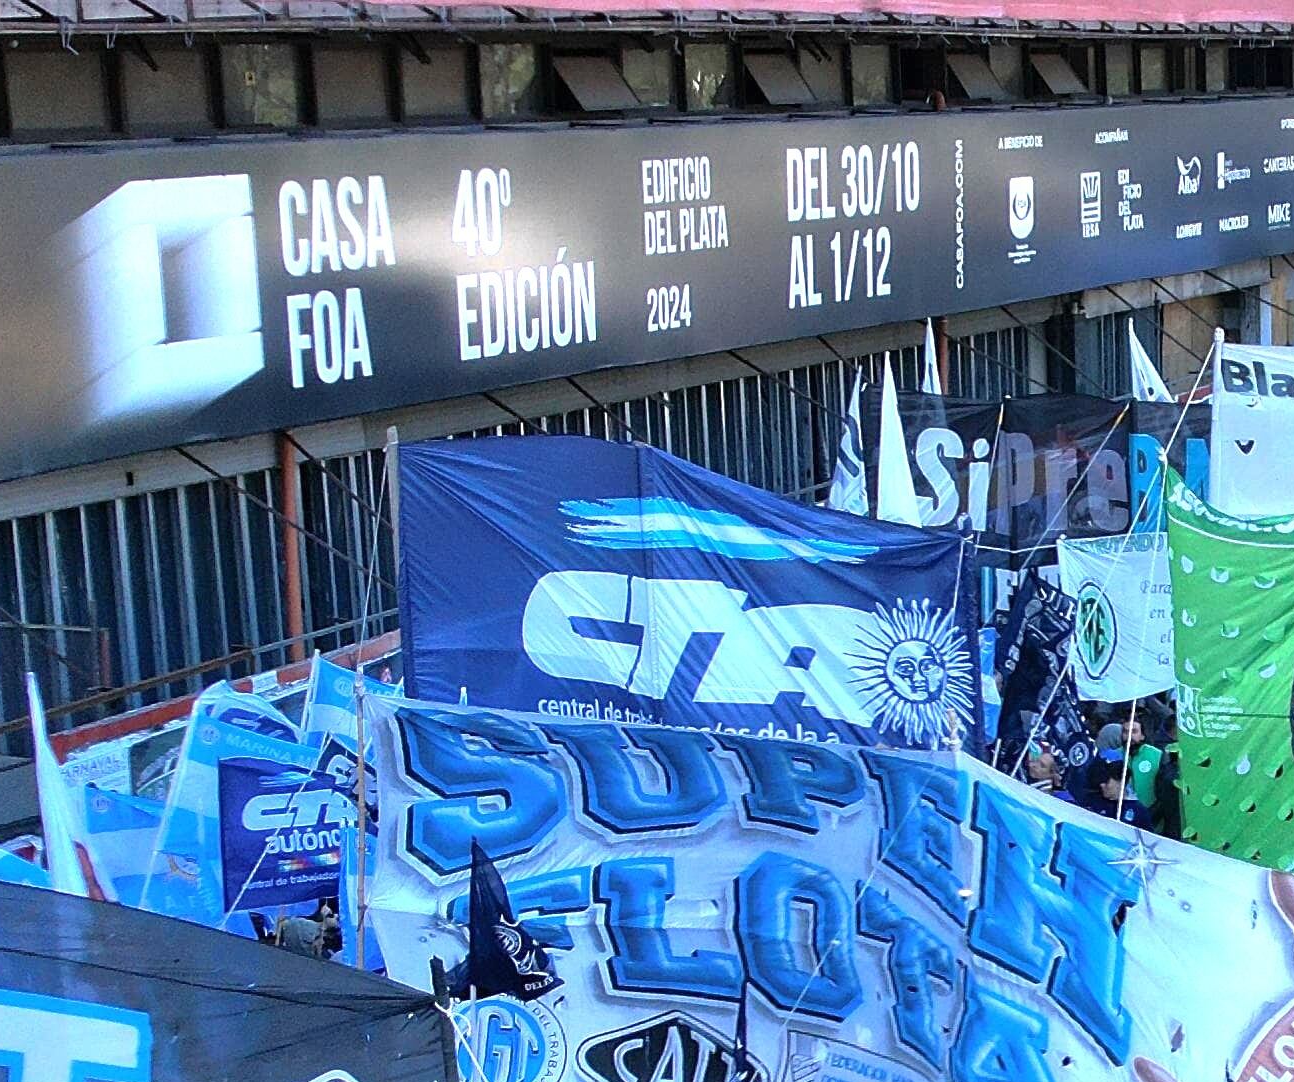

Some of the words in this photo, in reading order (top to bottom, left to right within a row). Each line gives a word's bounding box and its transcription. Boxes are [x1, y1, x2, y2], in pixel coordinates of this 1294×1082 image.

[641, 156, 711, 204] EDIFICIO
[786, 146, 833, 223] DEL
[840, 141, 920, 218] 30/10
[279, 175, 395, 278] CASA
[644, 211, 677, 256] DEL
[680, 204, 729, 253] PLATA
[457, 247, 597, 363] EDICIÓN
[647, 286, 693, 334] 2024
[788, 239, 824, 311] AL
[831, 226, 892, 300] 1/12
[288, 288, 374, 390] FOA
[522, 570, 878, 728] CTA
[538, 697, 600, 722] central
[604, 705, 621, 722] de
